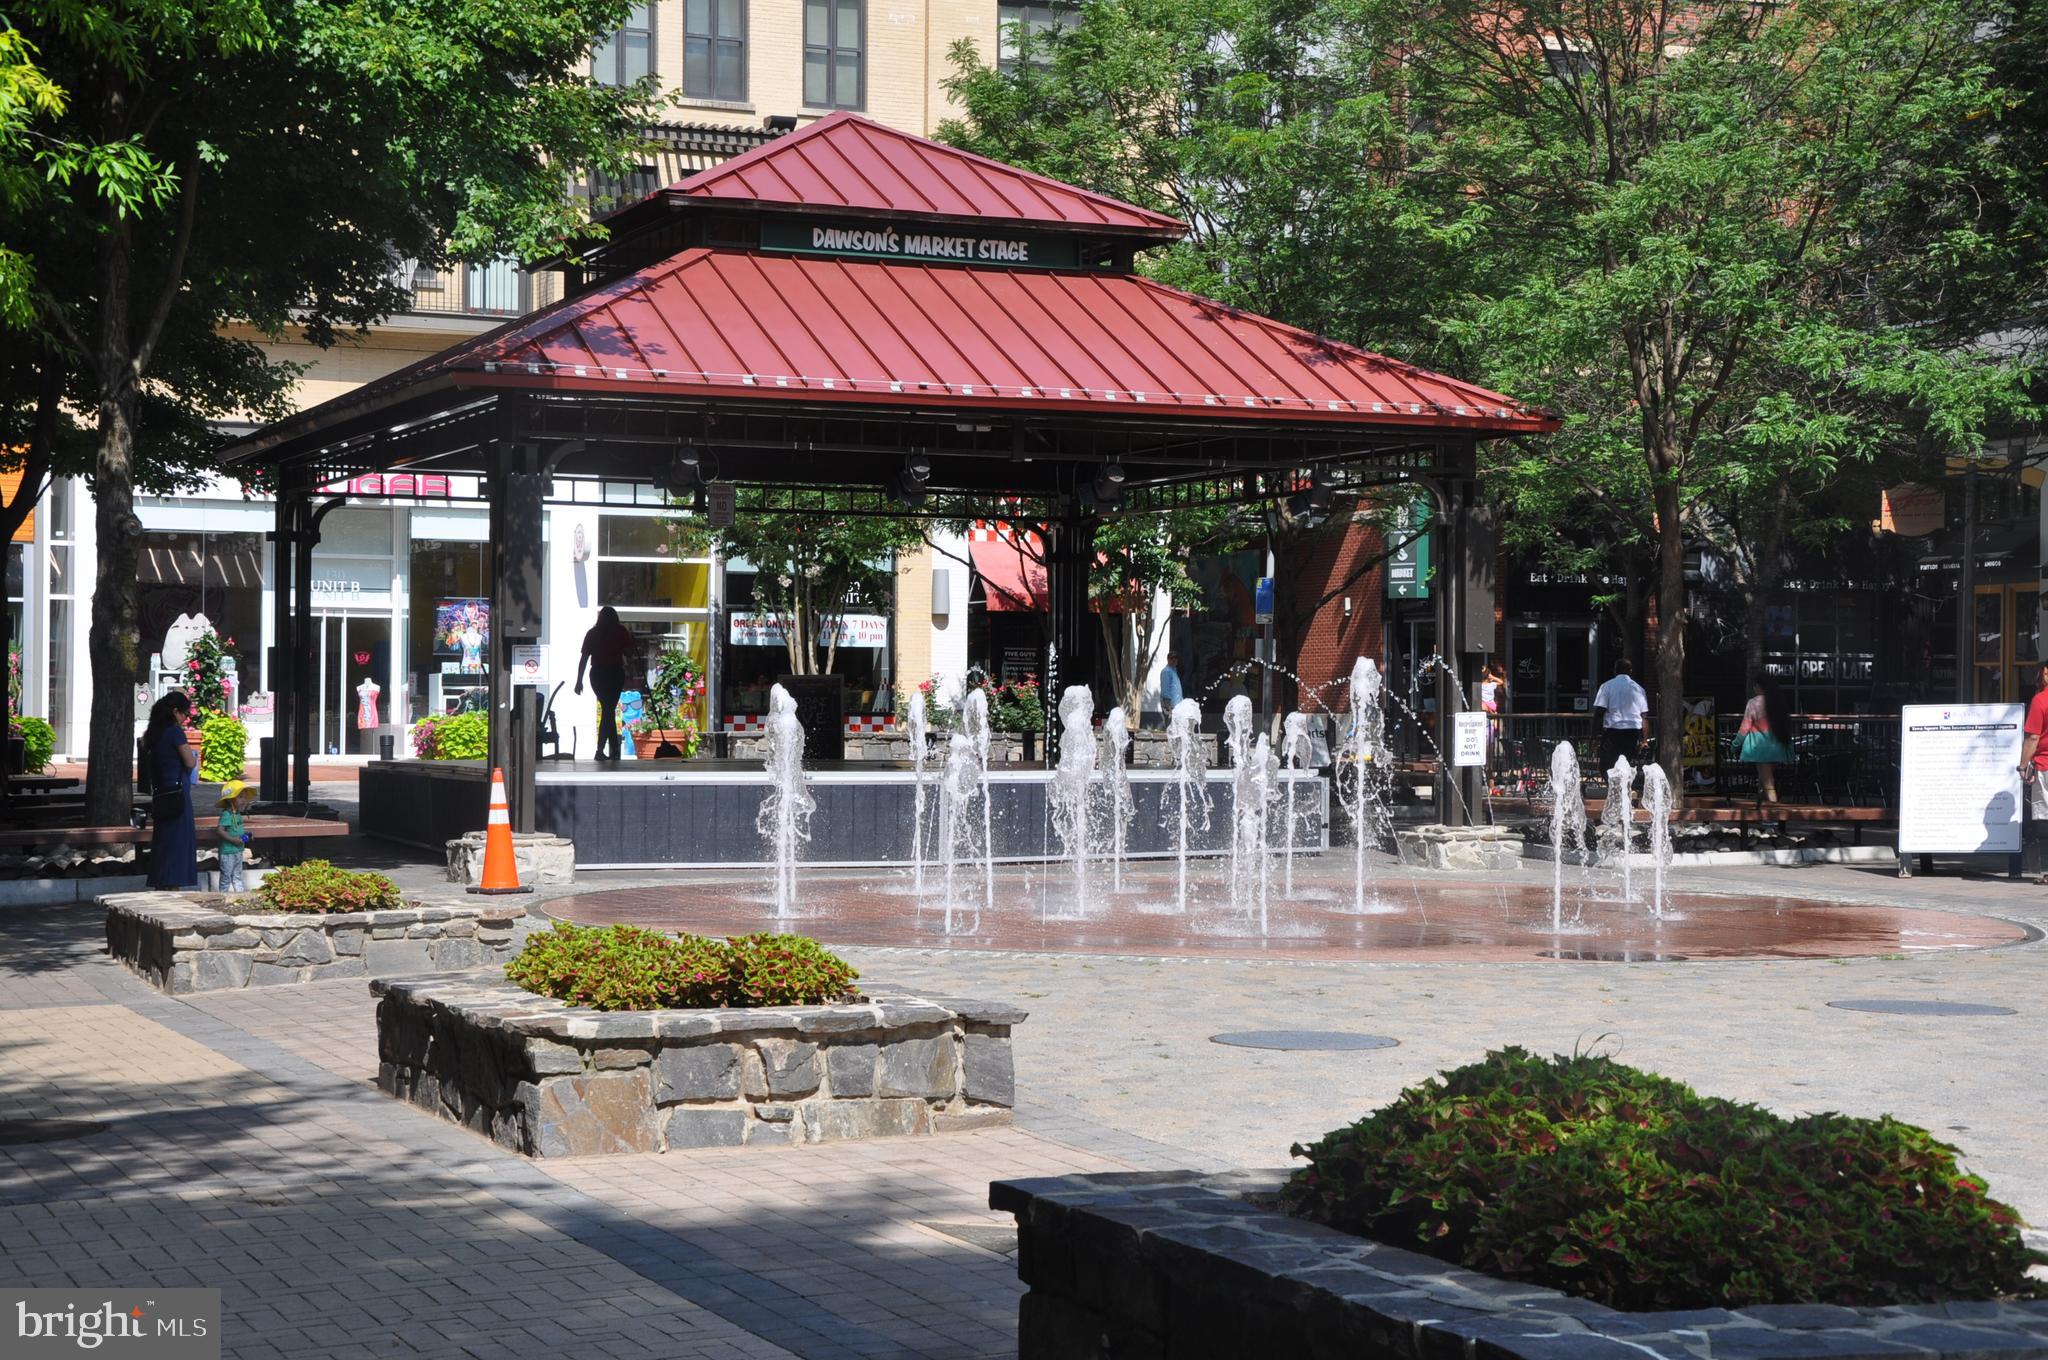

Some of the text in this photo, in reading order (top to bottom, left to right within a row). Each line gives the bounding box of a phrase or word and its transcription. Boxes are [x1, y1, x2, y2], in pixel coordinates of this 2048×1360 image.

[812, 226, 1029, 261] DAWSON'S MARKET STAGE
[1530, 572, 1548, 583] Eat
[1557, 573, 1588, 584] Drink
[310, 580, 361, 593] UNIT B
[852, 620, 858, 630] 7
[860, 620, 885, 630] DAYS
[869, 633, 884, 643] pm
[1801, 660, 1834, 679] OPEN
[1842, 661, 1873, 680] LATE
